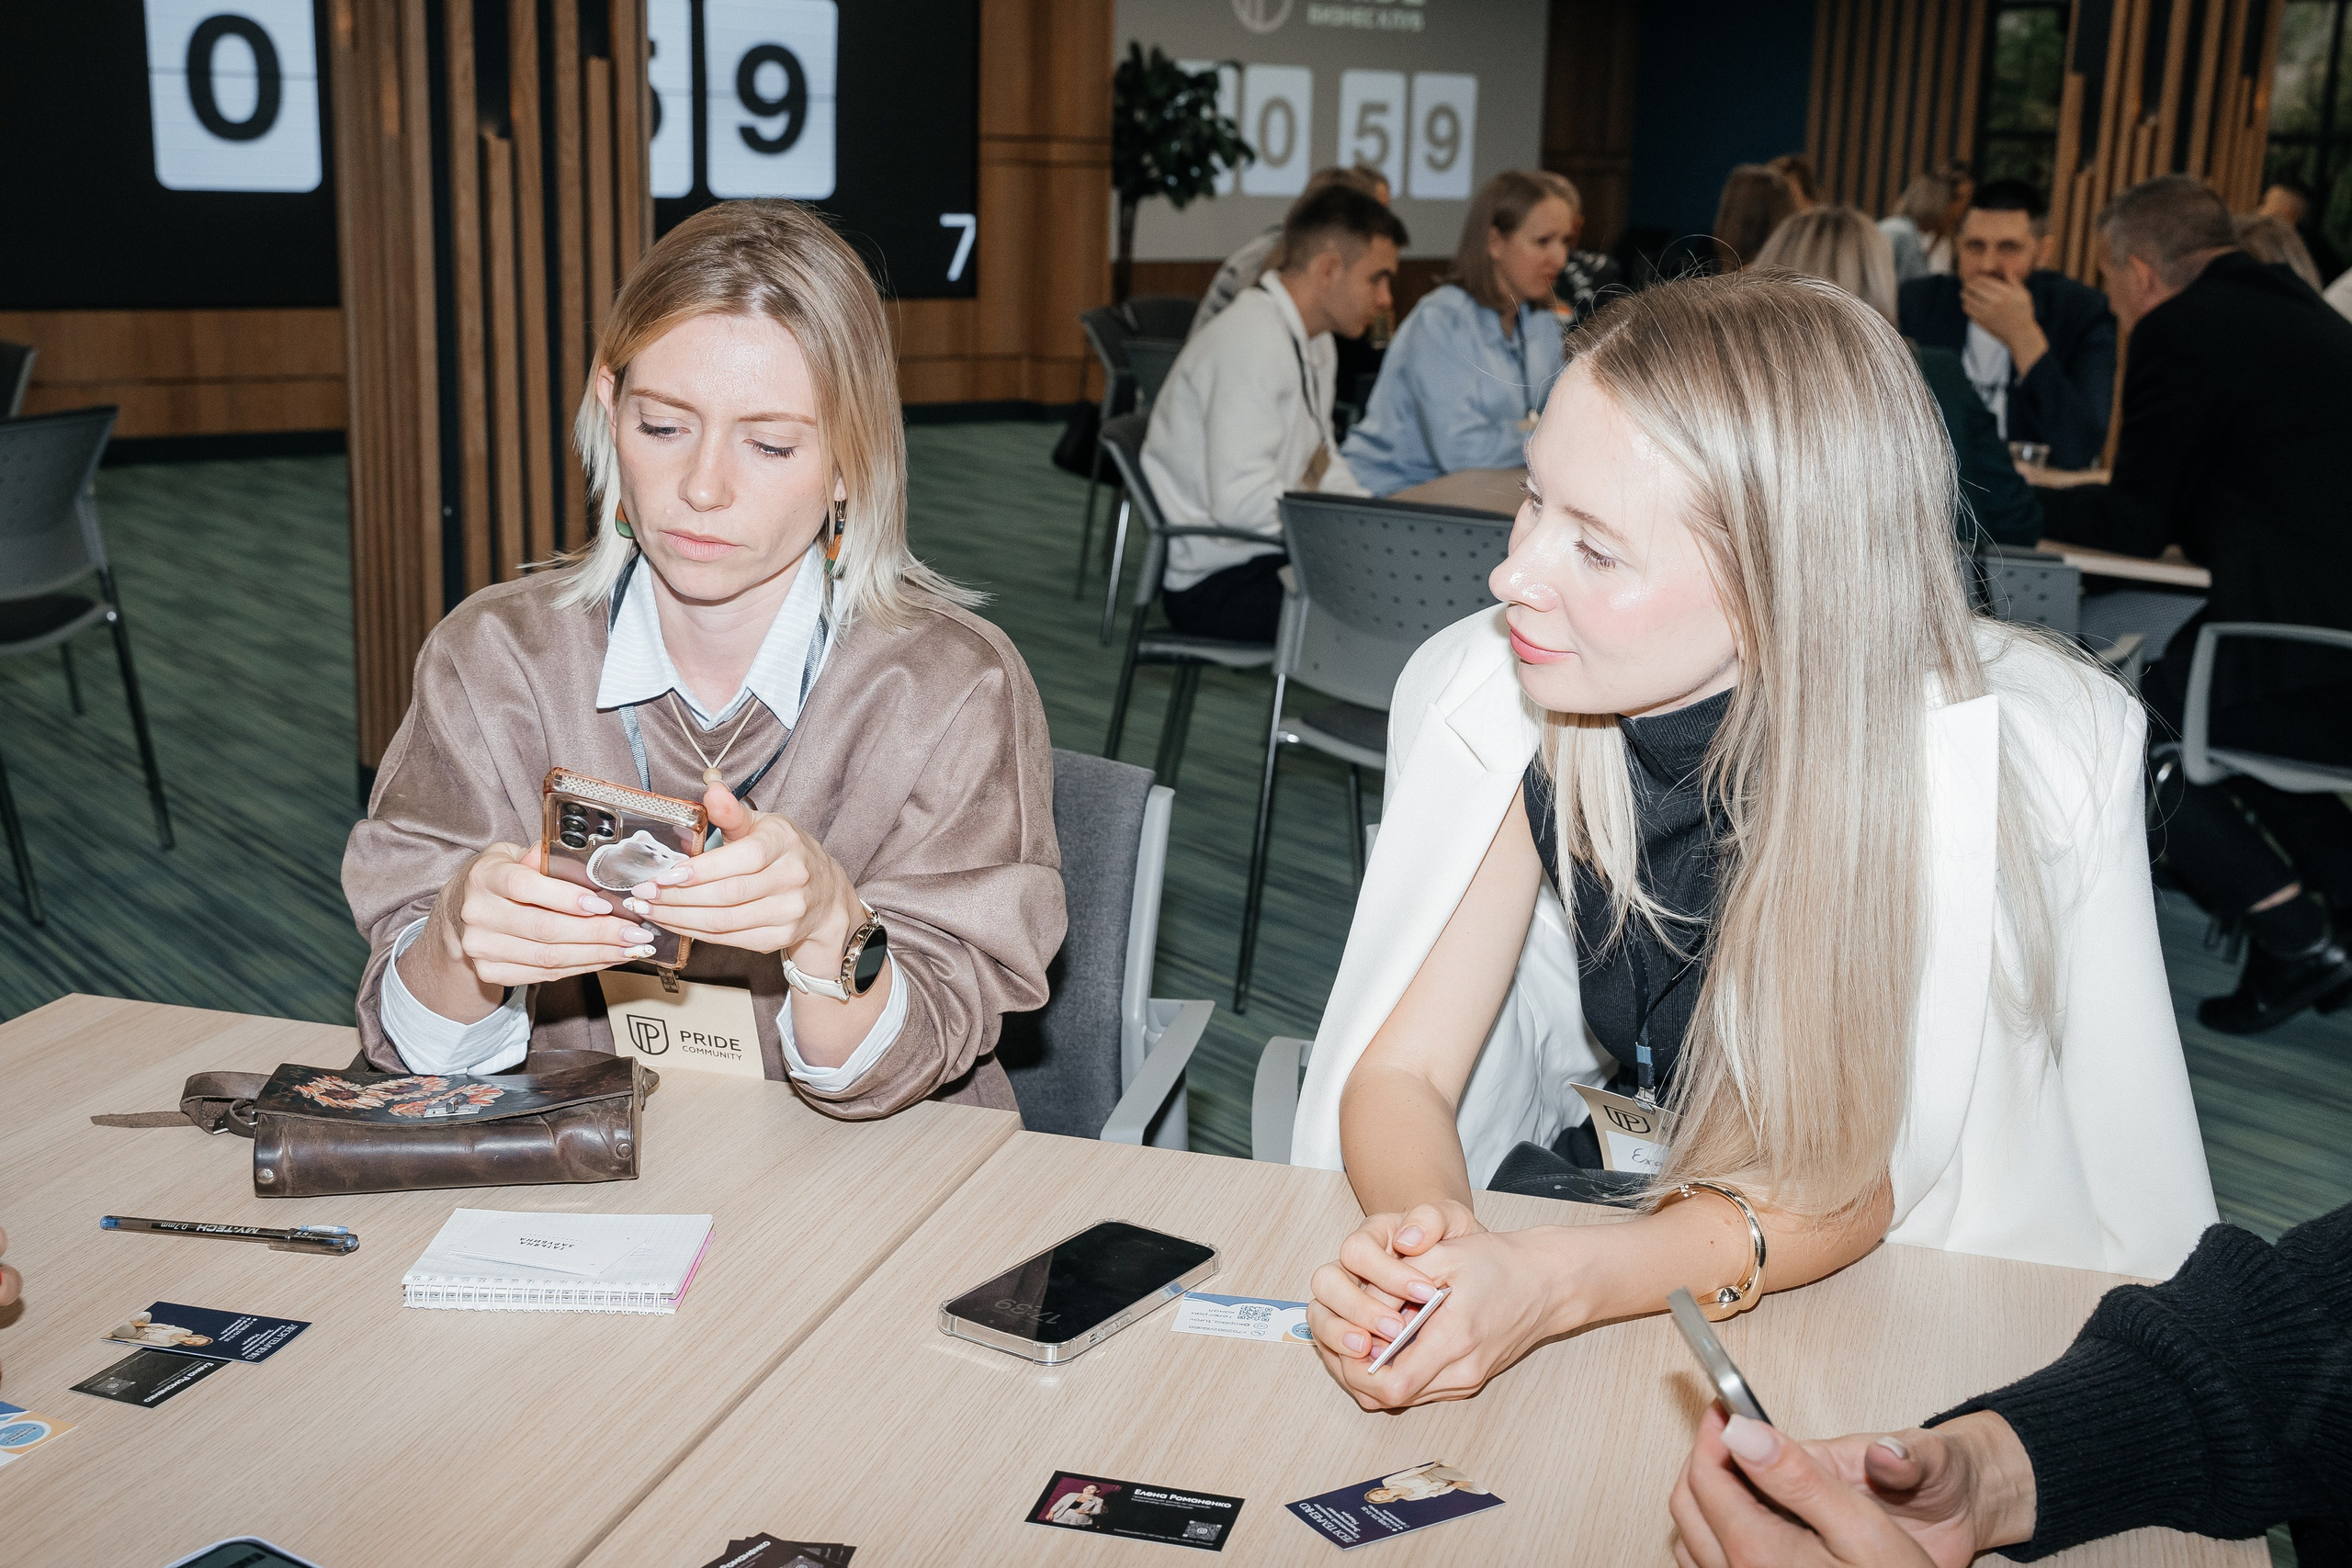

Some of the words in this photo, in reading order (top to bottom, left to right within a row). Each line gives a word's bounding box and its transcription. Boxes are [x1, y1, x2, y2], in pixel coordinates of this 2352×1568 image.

[184, 13, 283, 143] 0
[939, 213, 977, 281] 7
[680, 1030, 742, 1052] PRIDE
[682, 1045, 742, 1061] COMMUNITY
[995, 1299, 1061, 1324] 17:39
[1134, 1488, 1168, 1500] Елена
[1170, 1494, 1232, 1508] Романенко
